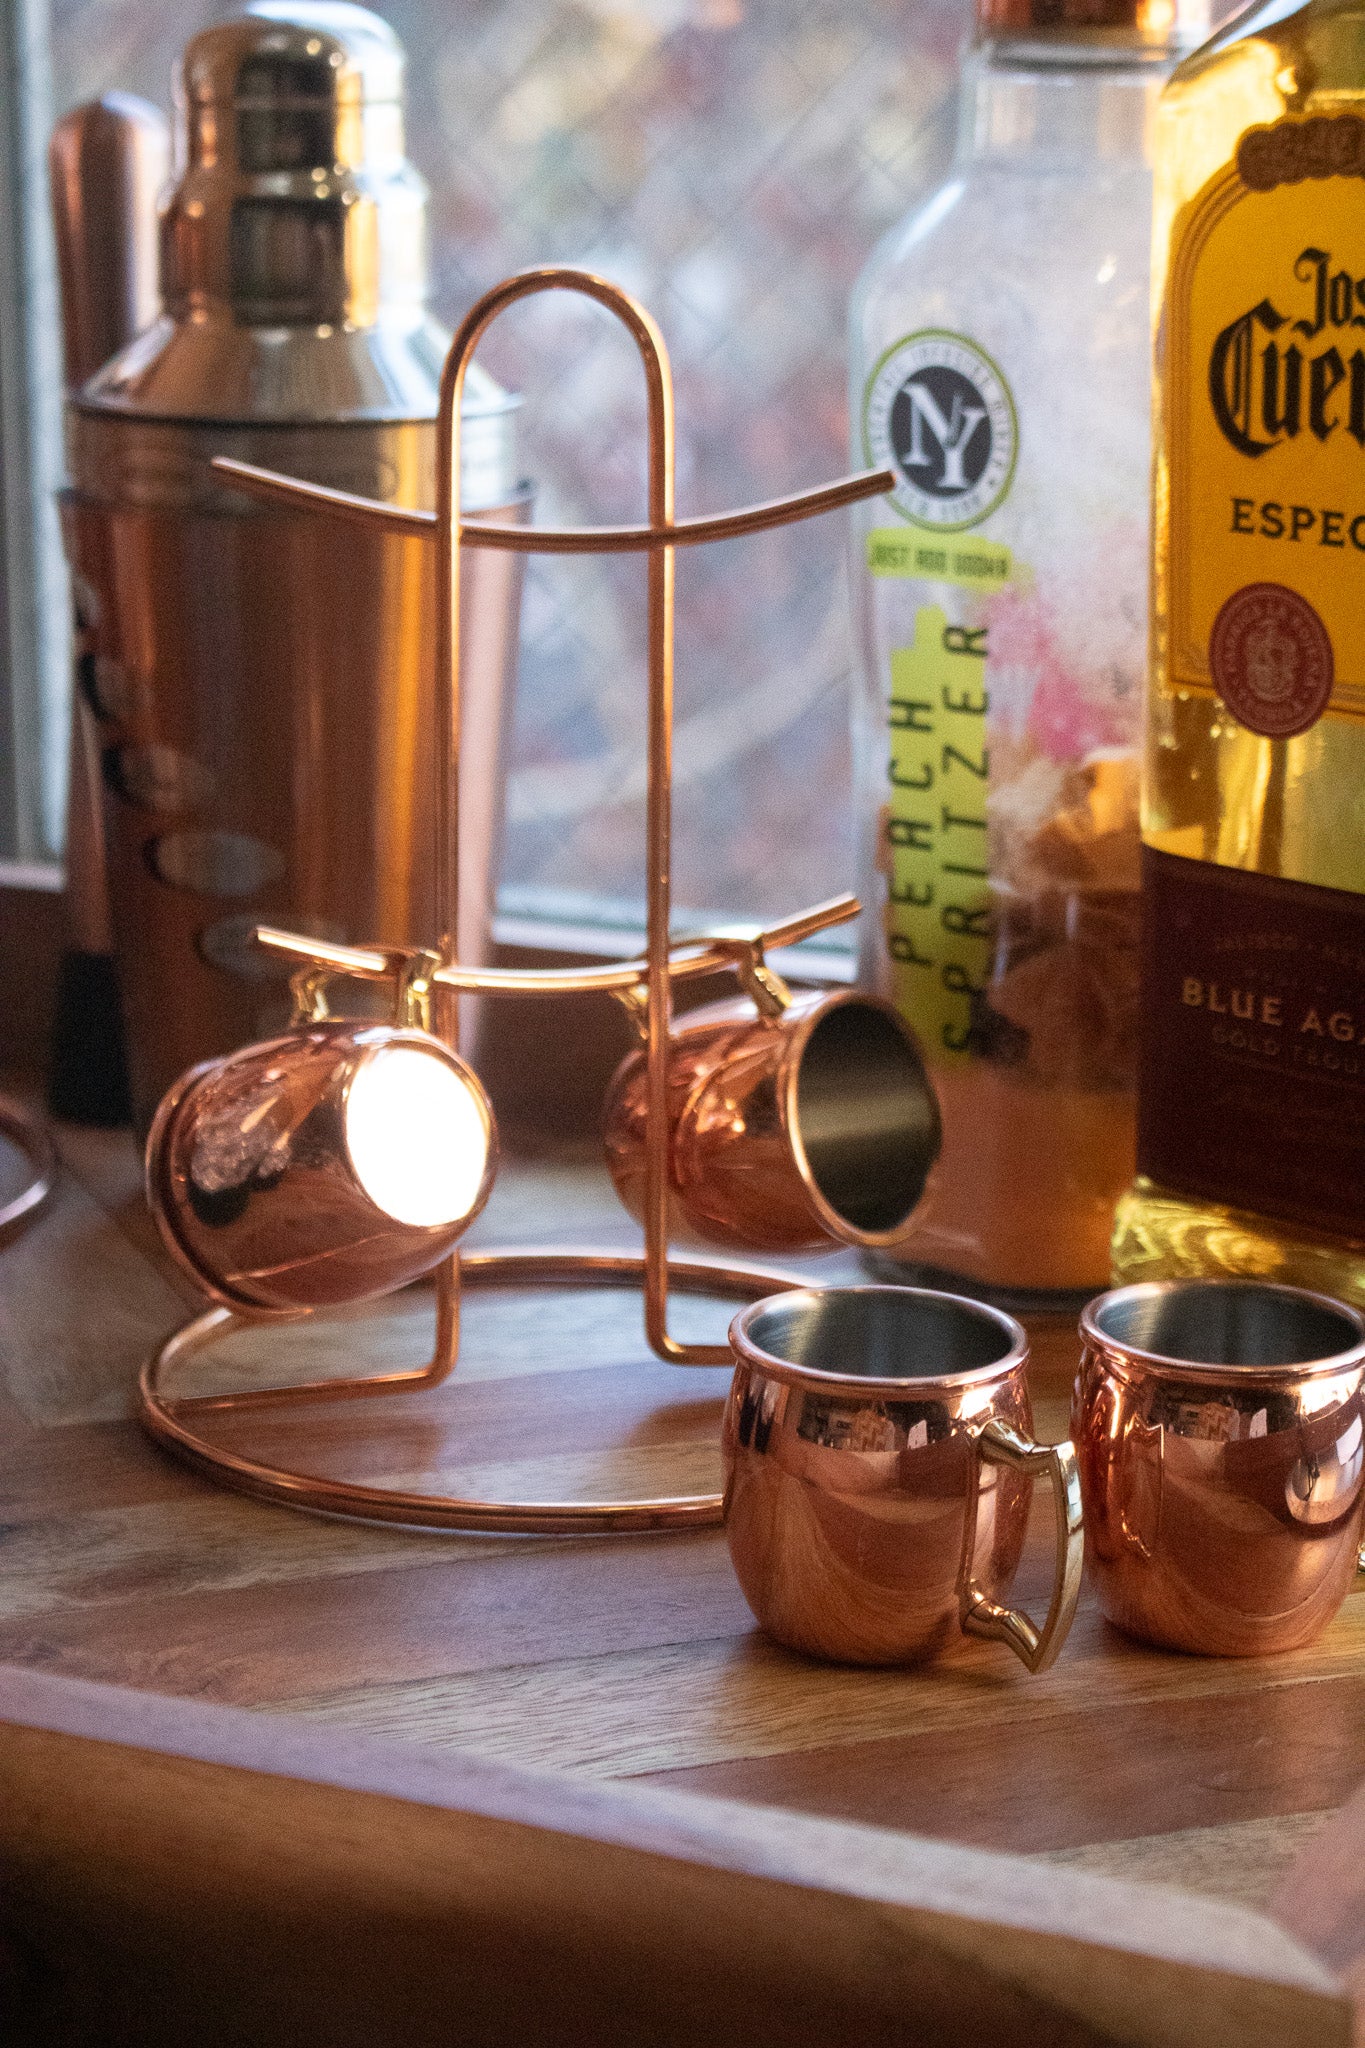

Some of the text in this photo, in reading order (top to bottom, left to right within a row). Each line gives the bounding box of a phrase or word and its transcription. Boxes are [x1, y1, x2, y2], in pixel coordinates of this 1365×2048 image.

[900, 382, 988, 489] NY
[887, 698, 934, 967] PEACH
[941, 625, 989, 1052] SPRITZER
[1181, 976, 1365, 1046] BLUE AG
